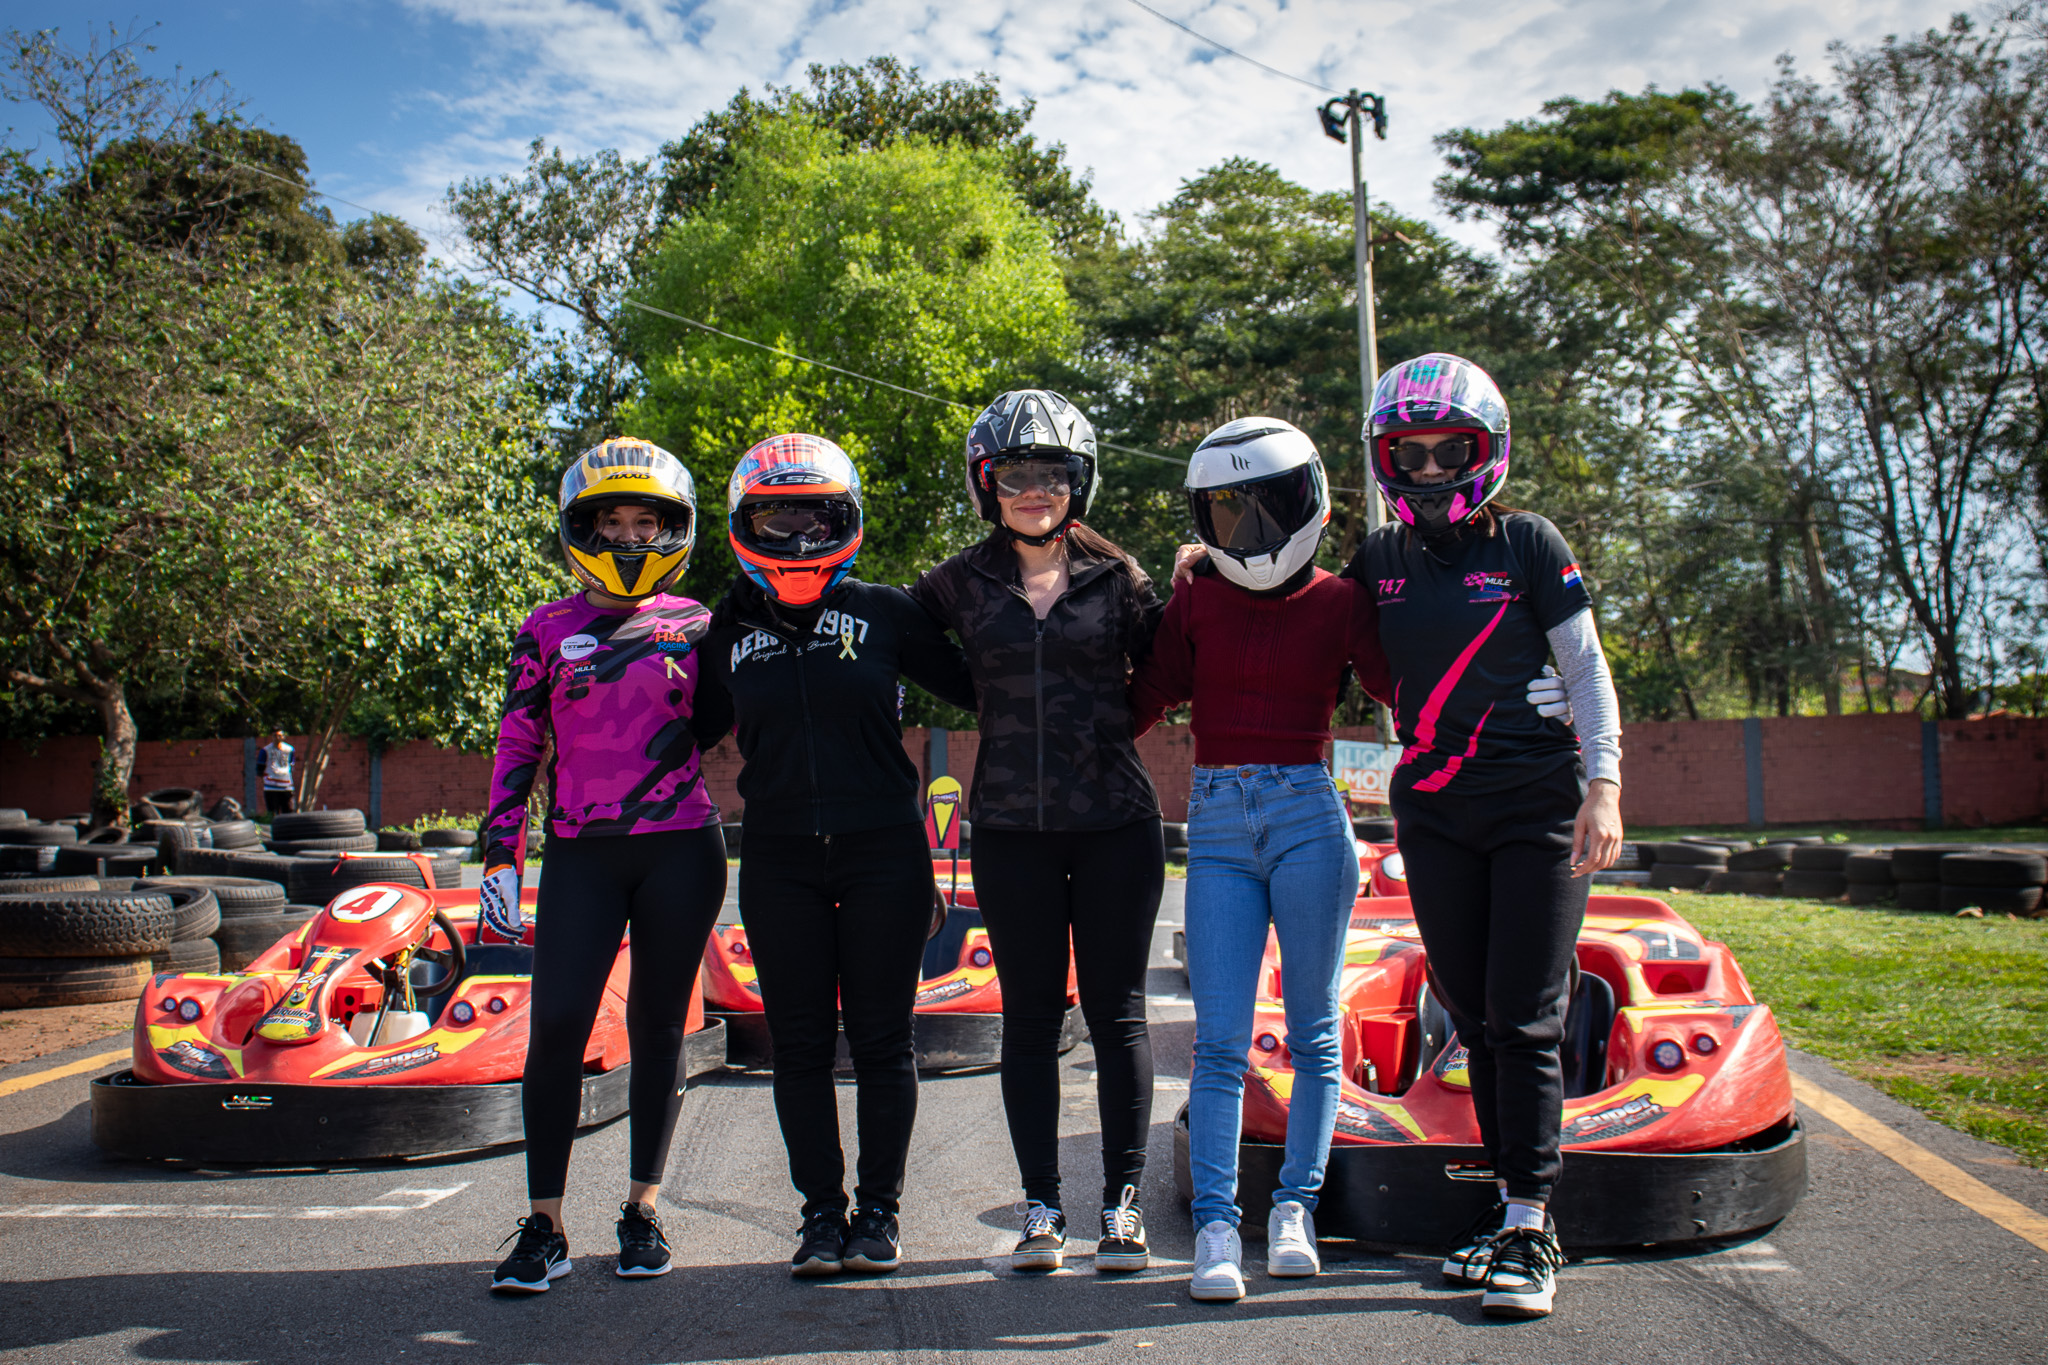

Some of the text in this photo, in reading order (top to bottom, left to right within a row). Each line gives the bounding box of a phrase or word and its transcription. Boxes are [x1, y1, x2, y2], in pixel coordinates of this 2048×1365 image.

[769, 475, 824, 486] LS2
[1378, 578, 1406, 596] 747
[1485, 577, 1512, 587] MULE
[654, 631, 688, 643] H&A
[813, 608, 869, 644] 1987
[752, 637, 840, 662] Original Brand
[574, 664, 597, 673] MULE
[1343, 769, 1391, 791] MOL
[336, 890, 388, 915] 4
[367, 1043, 439, 1071] Super
[1575, 1094, 1652, 1131] Super
